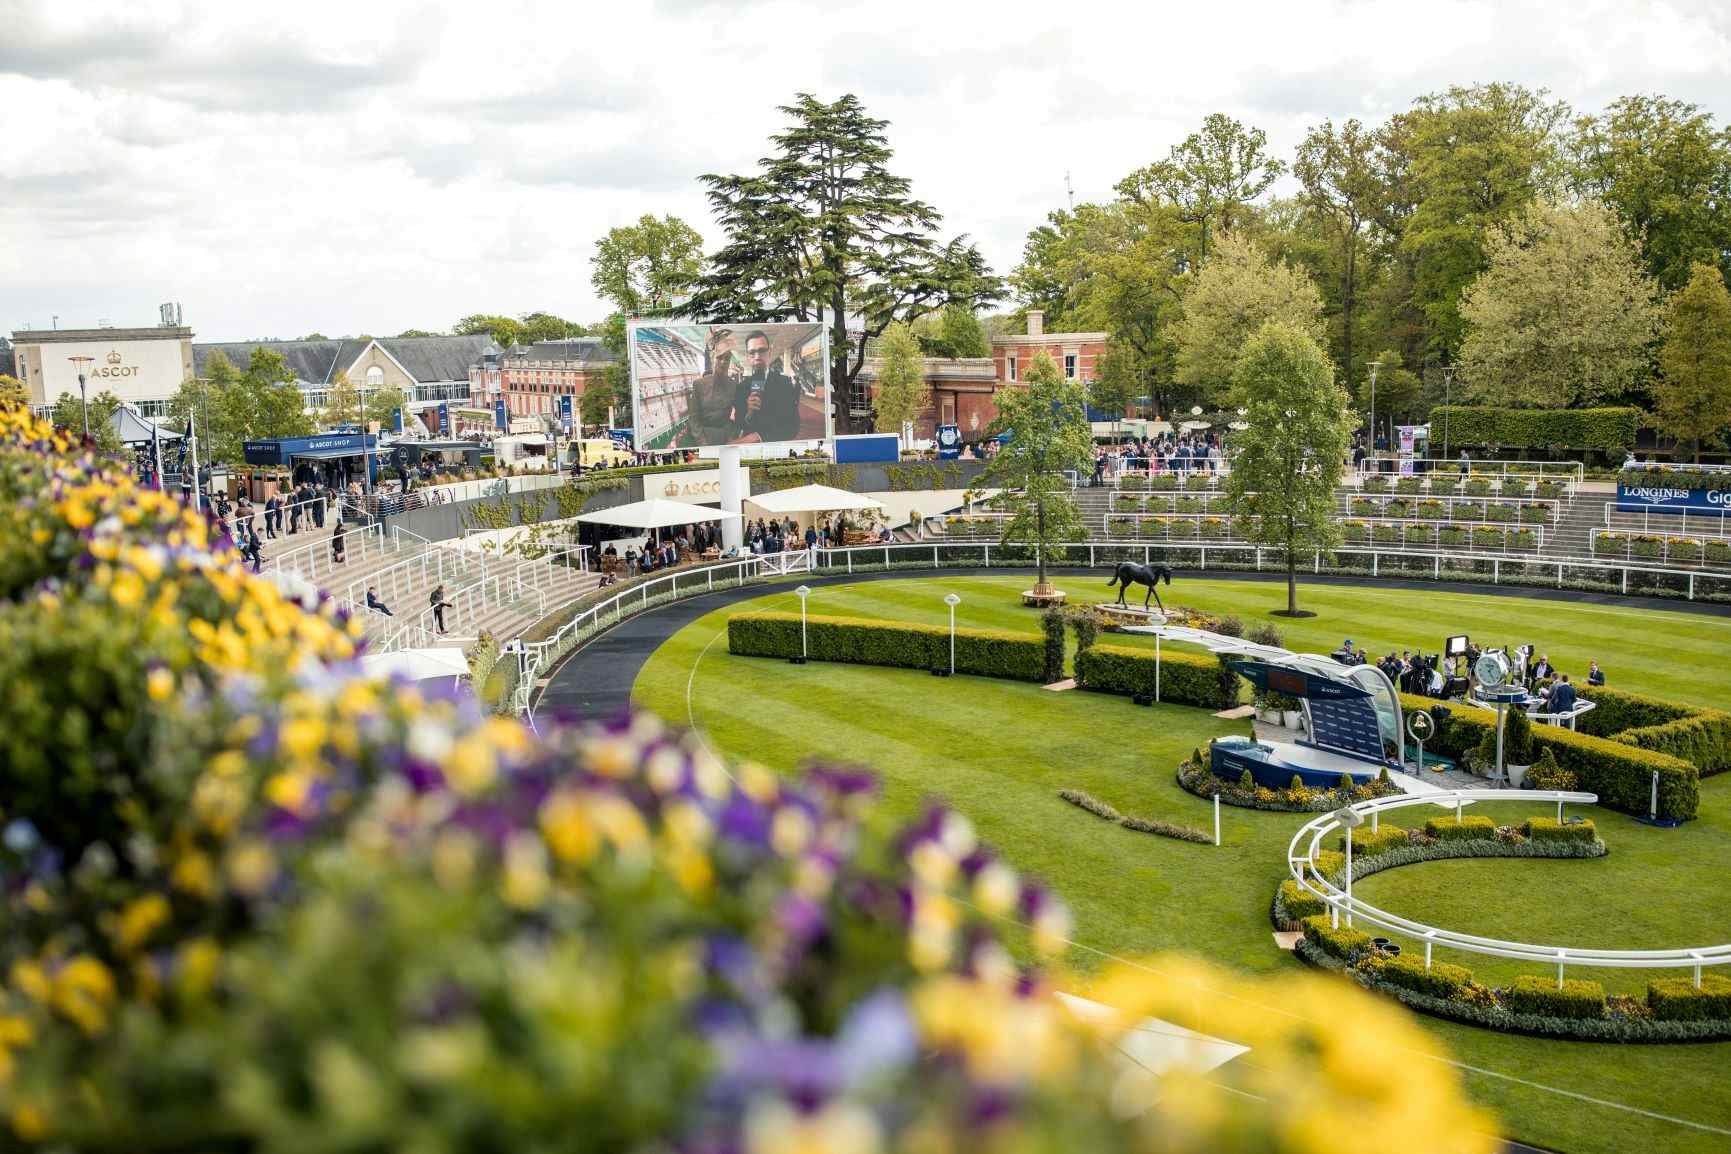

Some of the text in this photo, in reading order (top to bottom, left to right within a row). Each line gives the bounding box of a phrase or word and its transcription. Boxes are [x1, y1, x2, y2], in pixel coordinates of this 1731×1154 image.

[91, 366, 139, 378] ASCOT
[681, 481, 720, 495] ASCO
[1623, 487, 1689, 499] LONGINES
